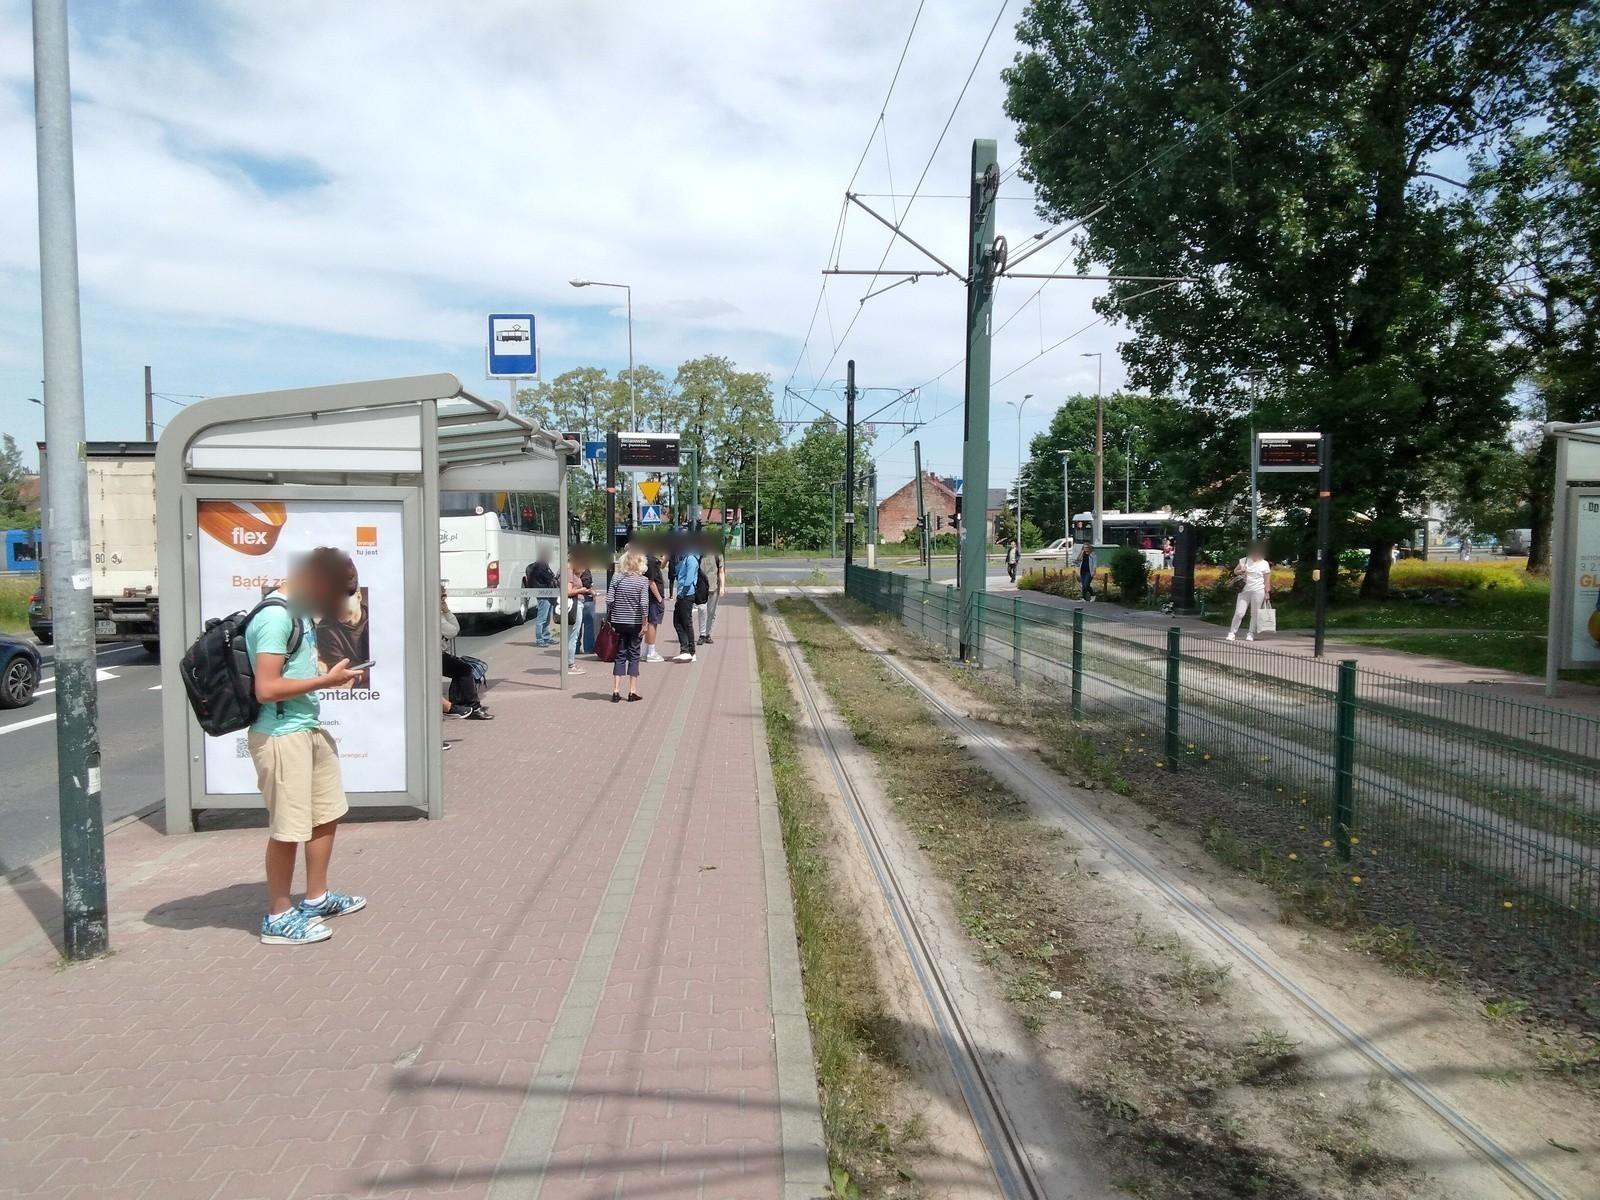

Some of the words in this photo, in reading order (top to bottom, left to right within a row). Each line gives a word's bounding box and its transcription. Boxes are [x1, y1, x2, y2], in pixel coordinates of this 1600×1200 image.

[231, 527, 268, 545] flex
[365, 548, 378, 557] jest
[232, 575, 269, 590] Bądź
[319, 689, 380, 700] ontakcie
